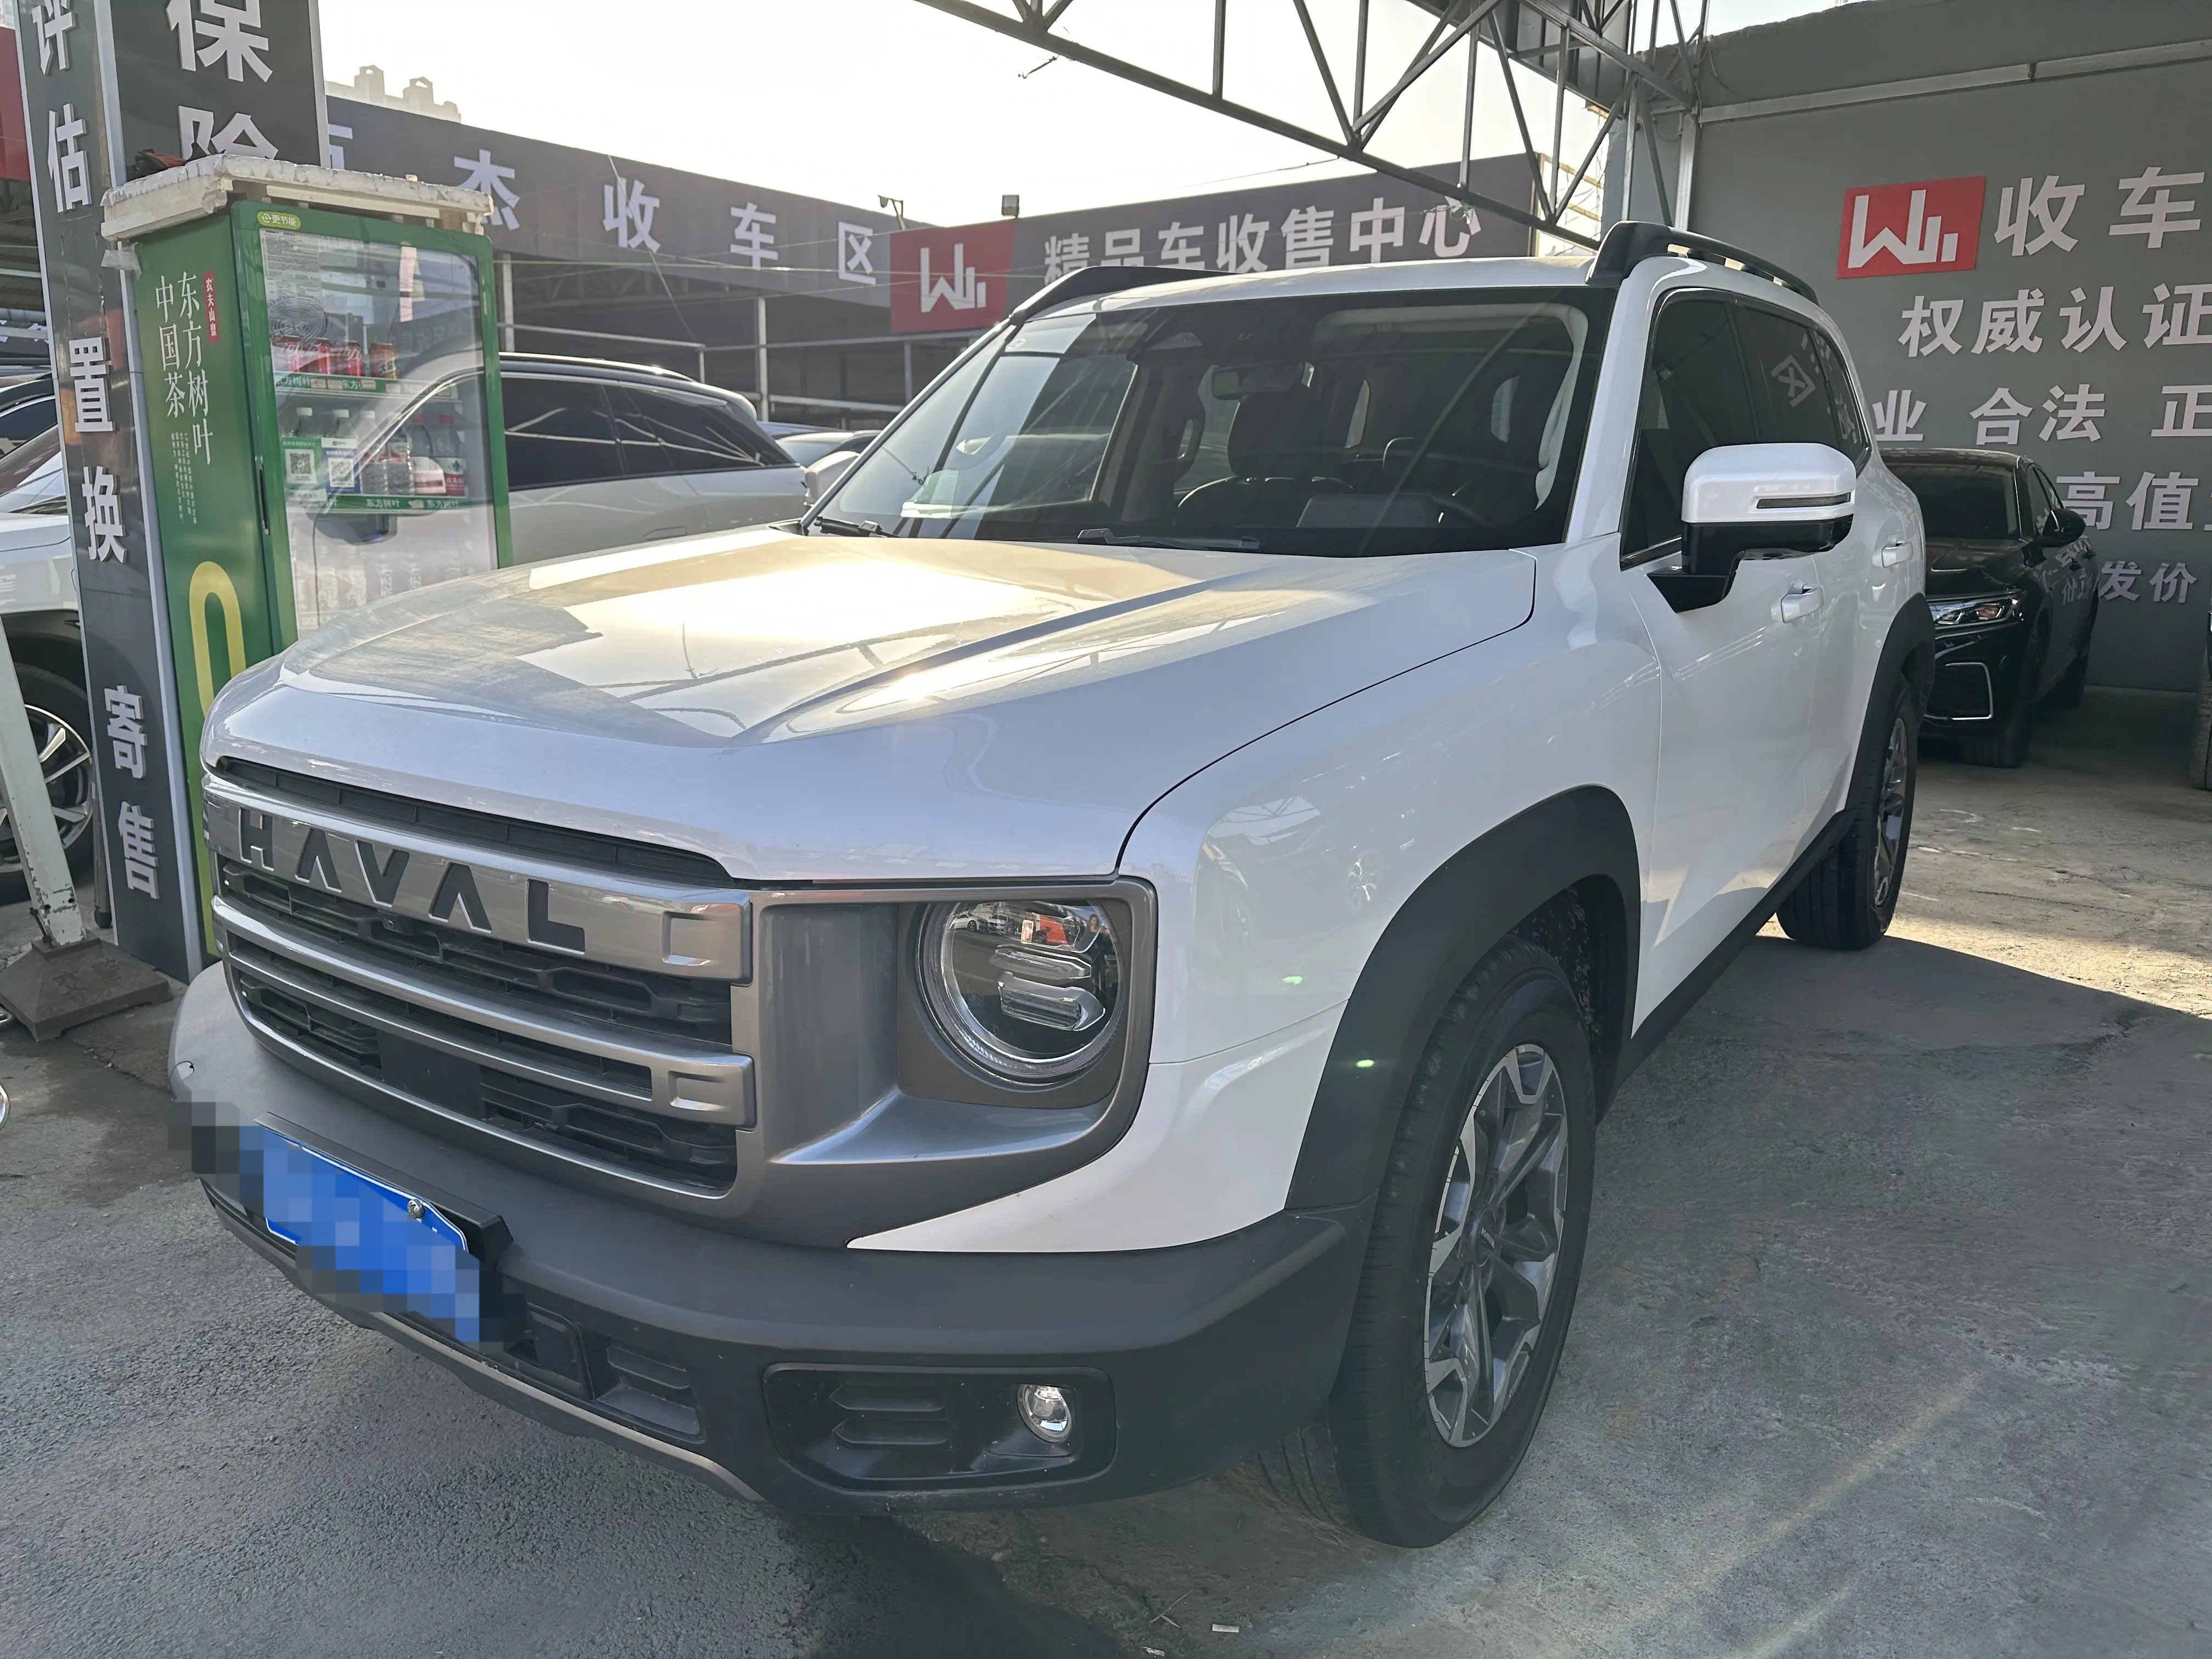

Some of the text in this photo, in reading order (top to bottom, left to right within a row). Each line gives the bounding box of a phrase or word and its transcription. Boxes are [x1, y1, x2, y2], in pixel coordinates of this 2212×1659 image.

[32, 0, 92, 214] 评估
[272, 215, 297, 226] 更节能
[1044, 196, 1481, 286] 精品车收售中心
[1994, 166, 2205, 257] 收车
[156, 275, 185, 418] 中国茶
[206, 277, 217, 337] 农夫山泉
[1898, 283, 2212, 358] 权威认证
[178, 271, 213, 465] 东方树叶
[69, 336, 127, 564] 置换
[1872, 384, 2212, 445] 业 合法 正
[2056, 471, 2212, 531] 高值
[2097, 561, 2198, 604] 发价
[104, 684, 160, 900] 寄售
[238, 806, 585, 955] HAVAL
